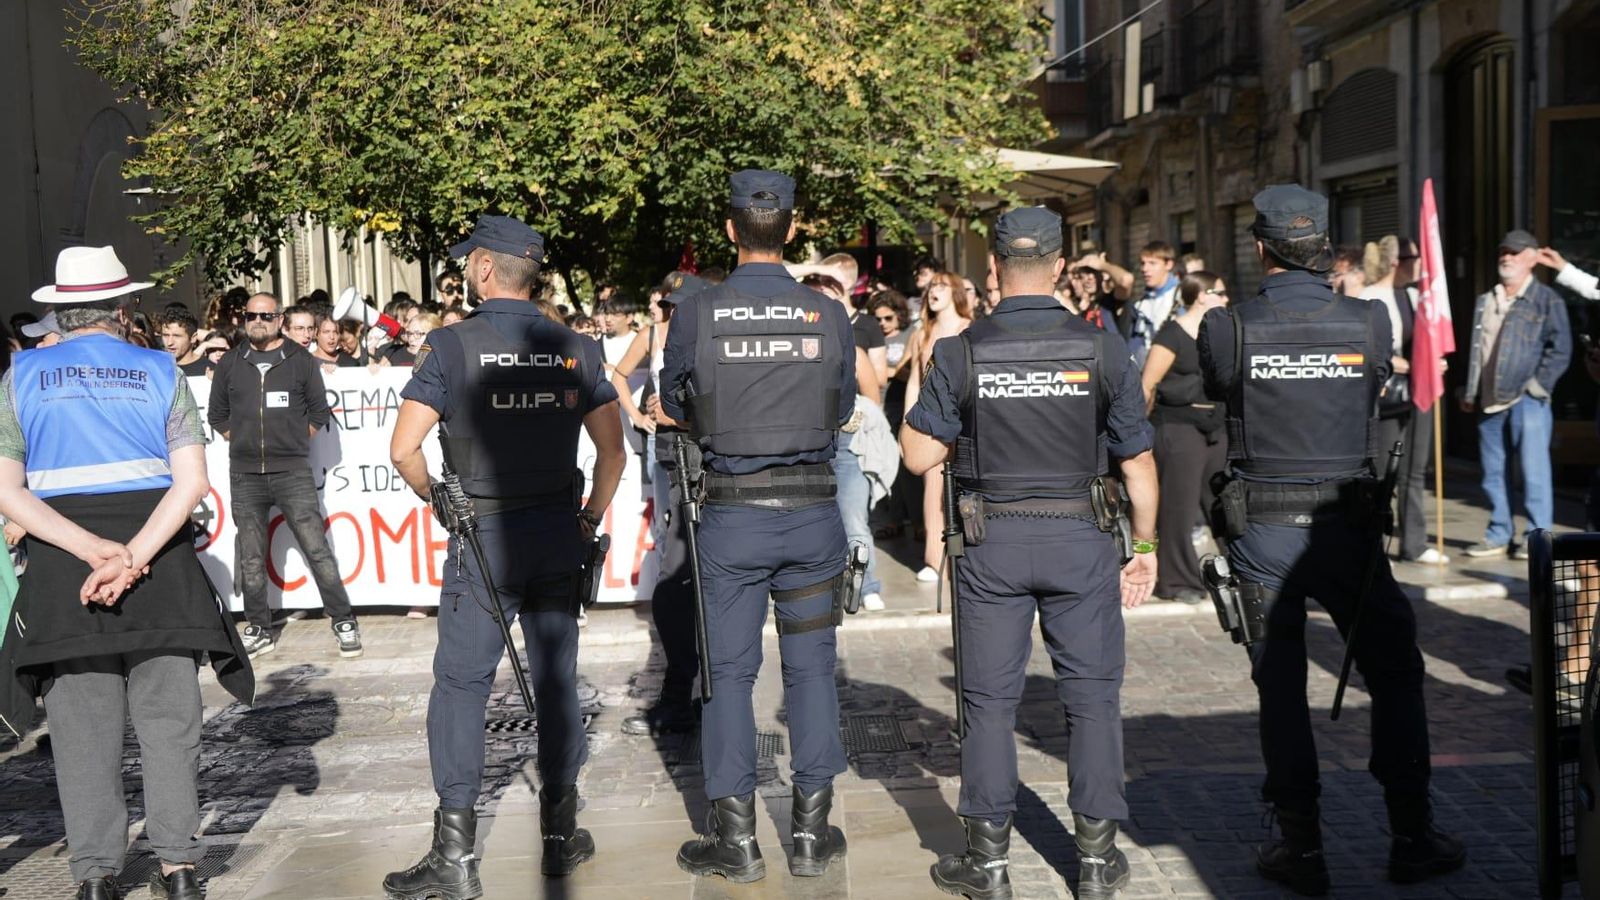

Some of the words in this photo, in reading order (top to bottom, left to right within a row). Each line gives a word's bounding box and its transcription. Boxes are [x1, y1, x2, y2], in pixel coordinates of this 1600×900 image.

[714, 306, 806, 321] POLICIA
[724, 341, 798, 357] U.I.P.
[480, 353, 566, 367] POLICIA
[1251, 354, 1341, 367] POLICIA
[66, 366, 148, 382] DEFENDER
[978, 371, 1066, 386] POLICIA
[1251, 366, 1363, 379] NACIONAL
[979, 384, 1089, 399] NACIONAL
[492, 392, 560, 409] U.I.P.
